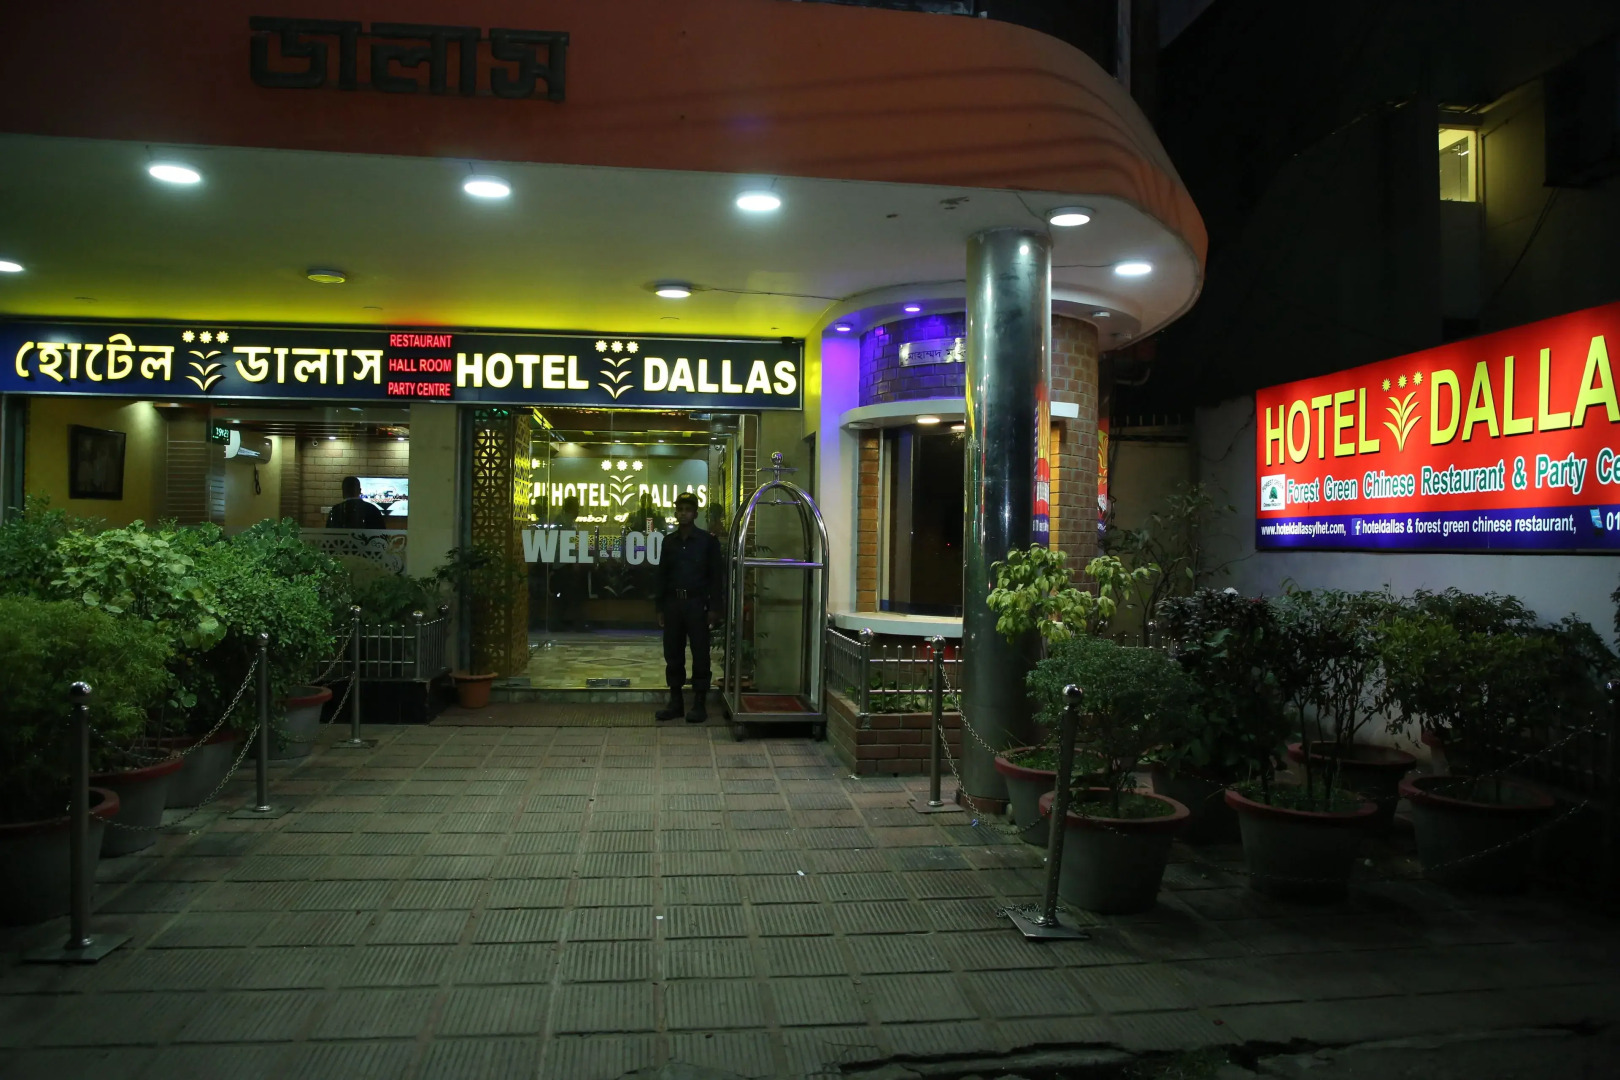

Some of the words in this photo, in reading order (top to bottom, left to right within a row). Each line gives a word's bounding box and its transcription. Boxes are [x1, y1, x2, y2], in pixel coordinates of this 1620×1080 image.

[249, 16, 569, 103] ডালাস
[389, 333, 452, 348] RESTAURANT
[15, 333, 175, 382] হোটেল
[232, 346, 384, 385] ডালাস
[388, 358, 417, 372] HALL
[419, 358, 452, 372] ROOM
[456, 352, 590, 390] HOTEL
[643, 356, 797, 395] DALLAS
[387, 381, 416, 397] PARTY
[417, 382, 451, 397] CENTRE
[1265, 387, 1380, 466] HOTEL
[1430, 335, 1620, 445] DALLA
[551, 482, 610, 507] HOTEL
[1286, 477, 1320, 504] Forest
[1324, 474, 1358, 501] Green
[1363, 470, 1415, 499] Chinese
[1421, 459, 1505, 496] Restaurant
[1512, 456, 1527, 490] &
[1535, 452, 1587, 495] Party
[1362, 518, 1405, 534] hoteldallas
[1406, 518, 1413, 533] &
[1415, 517, 1441, 533] forest
[1443, 521, 1469, 537] green
[1472, 516, 1512, 532] chinese
[1514, 514, 1576, 534] restaurant,
[625, 531, 664, 566] CO
